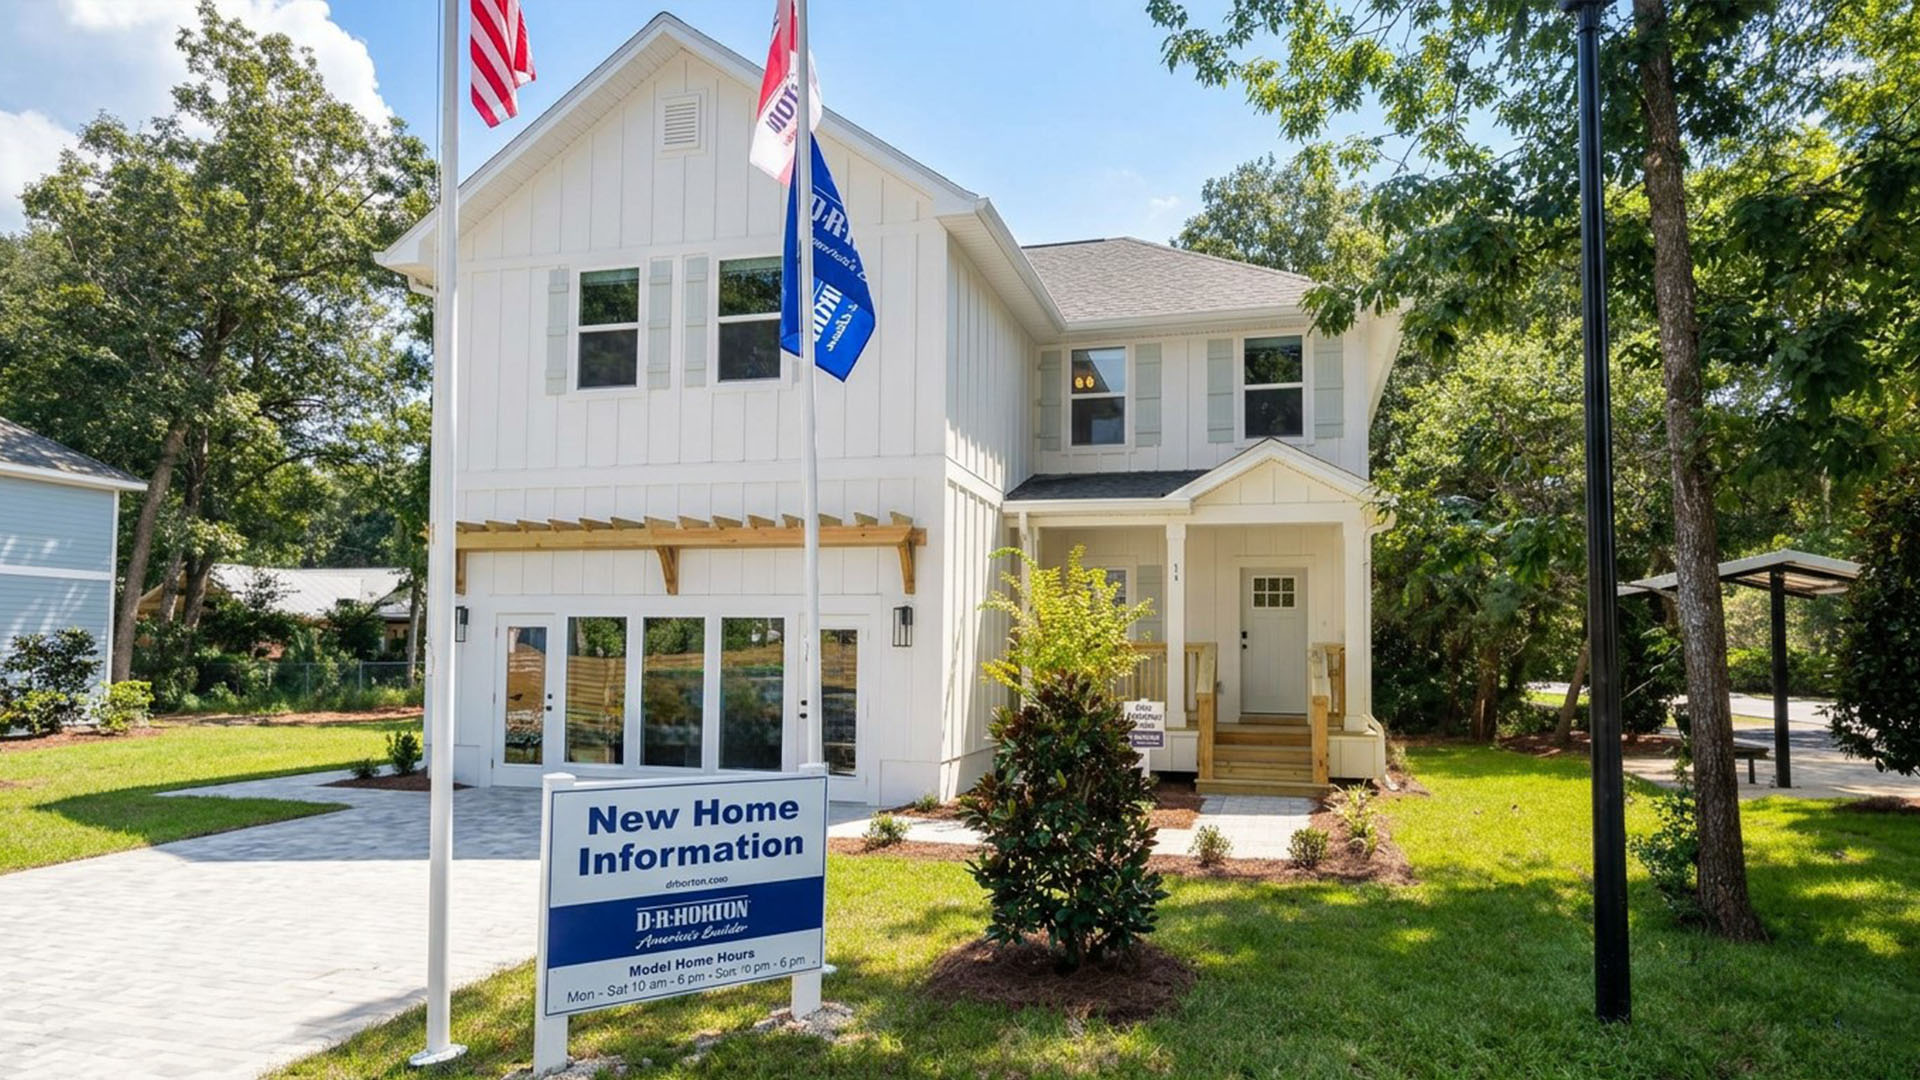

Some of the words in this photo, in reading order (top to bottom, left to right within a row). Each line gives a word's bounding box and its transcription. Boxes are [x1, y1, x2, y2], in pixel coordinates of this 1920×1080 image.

[588, 805, 680, 835] New
[693, 798, 800, 827] Home
[578, 832, 804, 876] Information
[567, 991, 595, 1003] Mon
[607, 983, 628, 997] Sat
[632, 980, 646, 992] 10
[649, 979, 667, 990] am
[677, 973, 685, 985] 6
[687, 973, 705, 985] pm
[754, 962, 770, 975] pm
[780, 956, 788, 968] 6
[789, 956, 806, 969] pm
[629, 960, 671, 977] Model
[675, 955, 714, 971] Home
[717, 949, 756, 963] Hours
